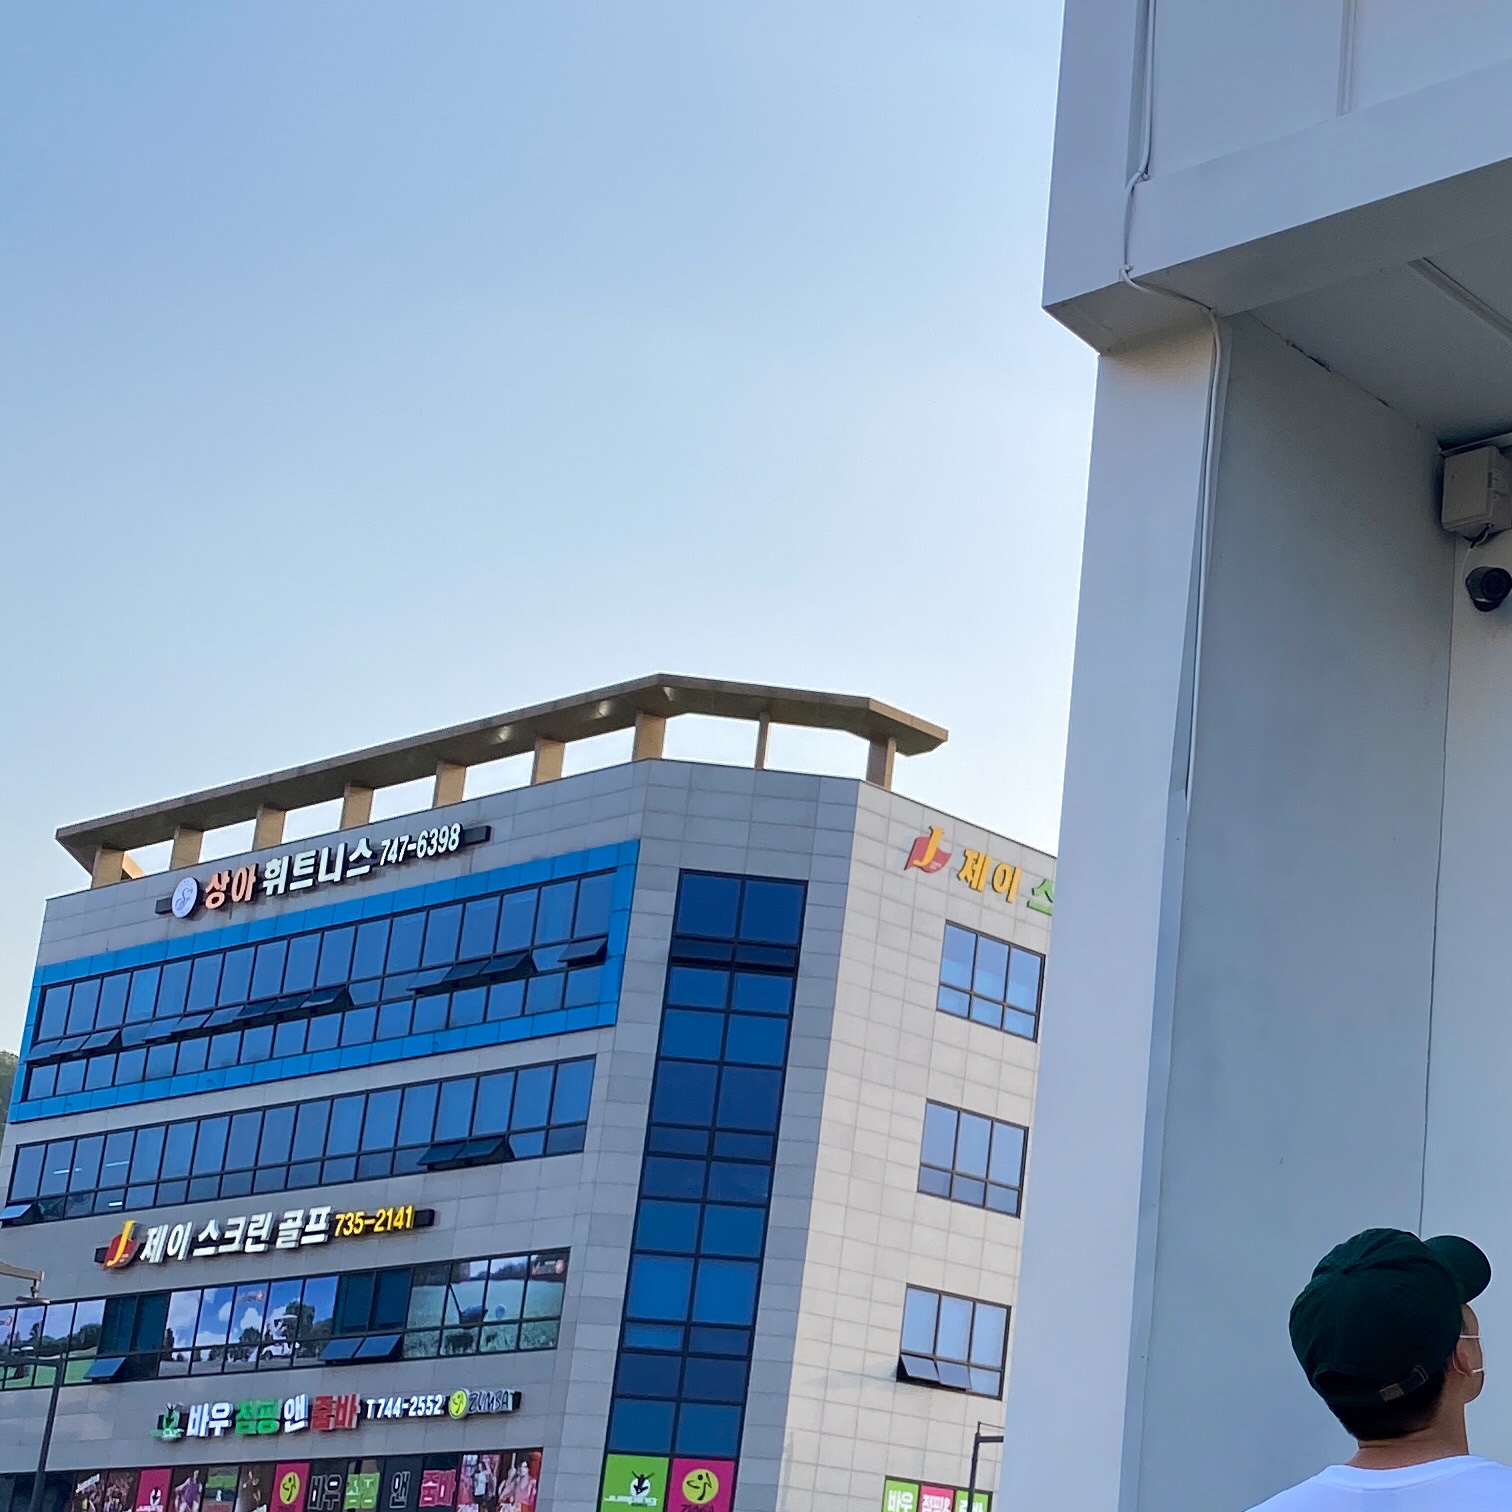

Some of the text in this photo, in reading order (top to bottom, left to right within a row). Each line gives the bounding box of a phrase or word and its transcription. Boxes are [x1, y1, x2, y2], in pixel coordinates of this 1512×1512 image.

[204, 864, 258, 910] 상아
[262, 842, 373, 896] 휘트니스
[379, 823, 462, 866] 747-6398
[957, 848, 1022, 904] 제이
[334, 1206, 414, 1237] 735-2141
